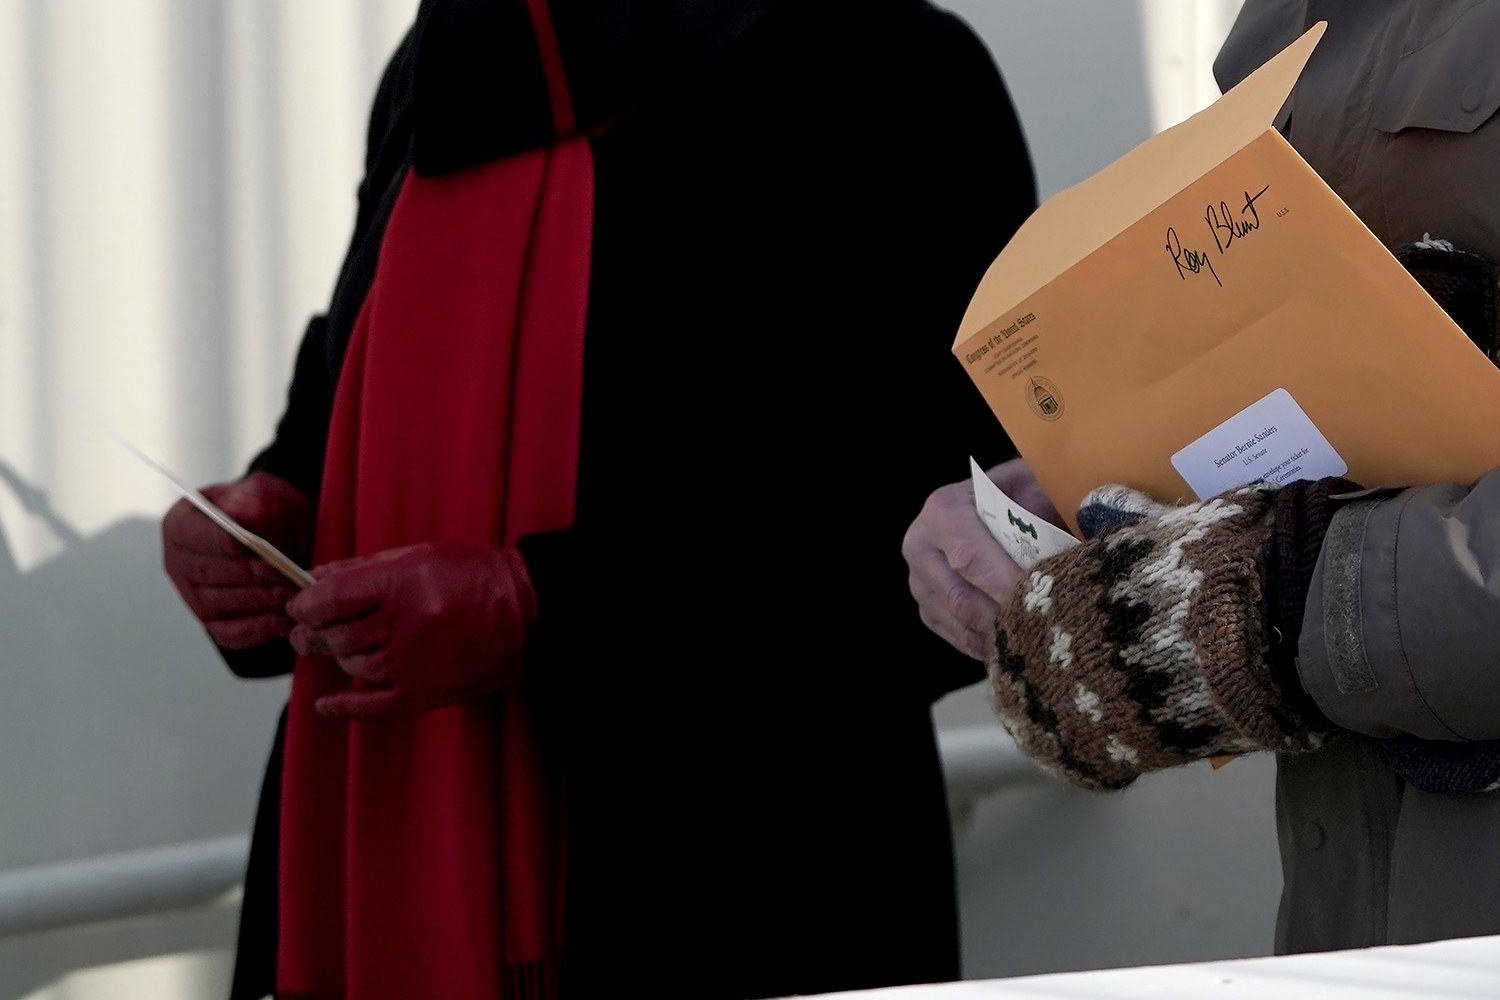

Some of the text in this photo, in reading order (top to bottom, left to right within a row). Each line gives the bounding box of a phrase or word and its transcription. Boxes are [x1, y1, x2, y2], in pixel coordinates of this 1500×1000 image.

[1166, 185, 1270, 287] Roy Blunt
[1213, 425, 1278, 468] Senator Bernie Sanders
[1242, 448, 1268, 466] U.S. Senate
[1262, 464, 1281, 479] envelope
[1280, 458, 1292, 469] your
